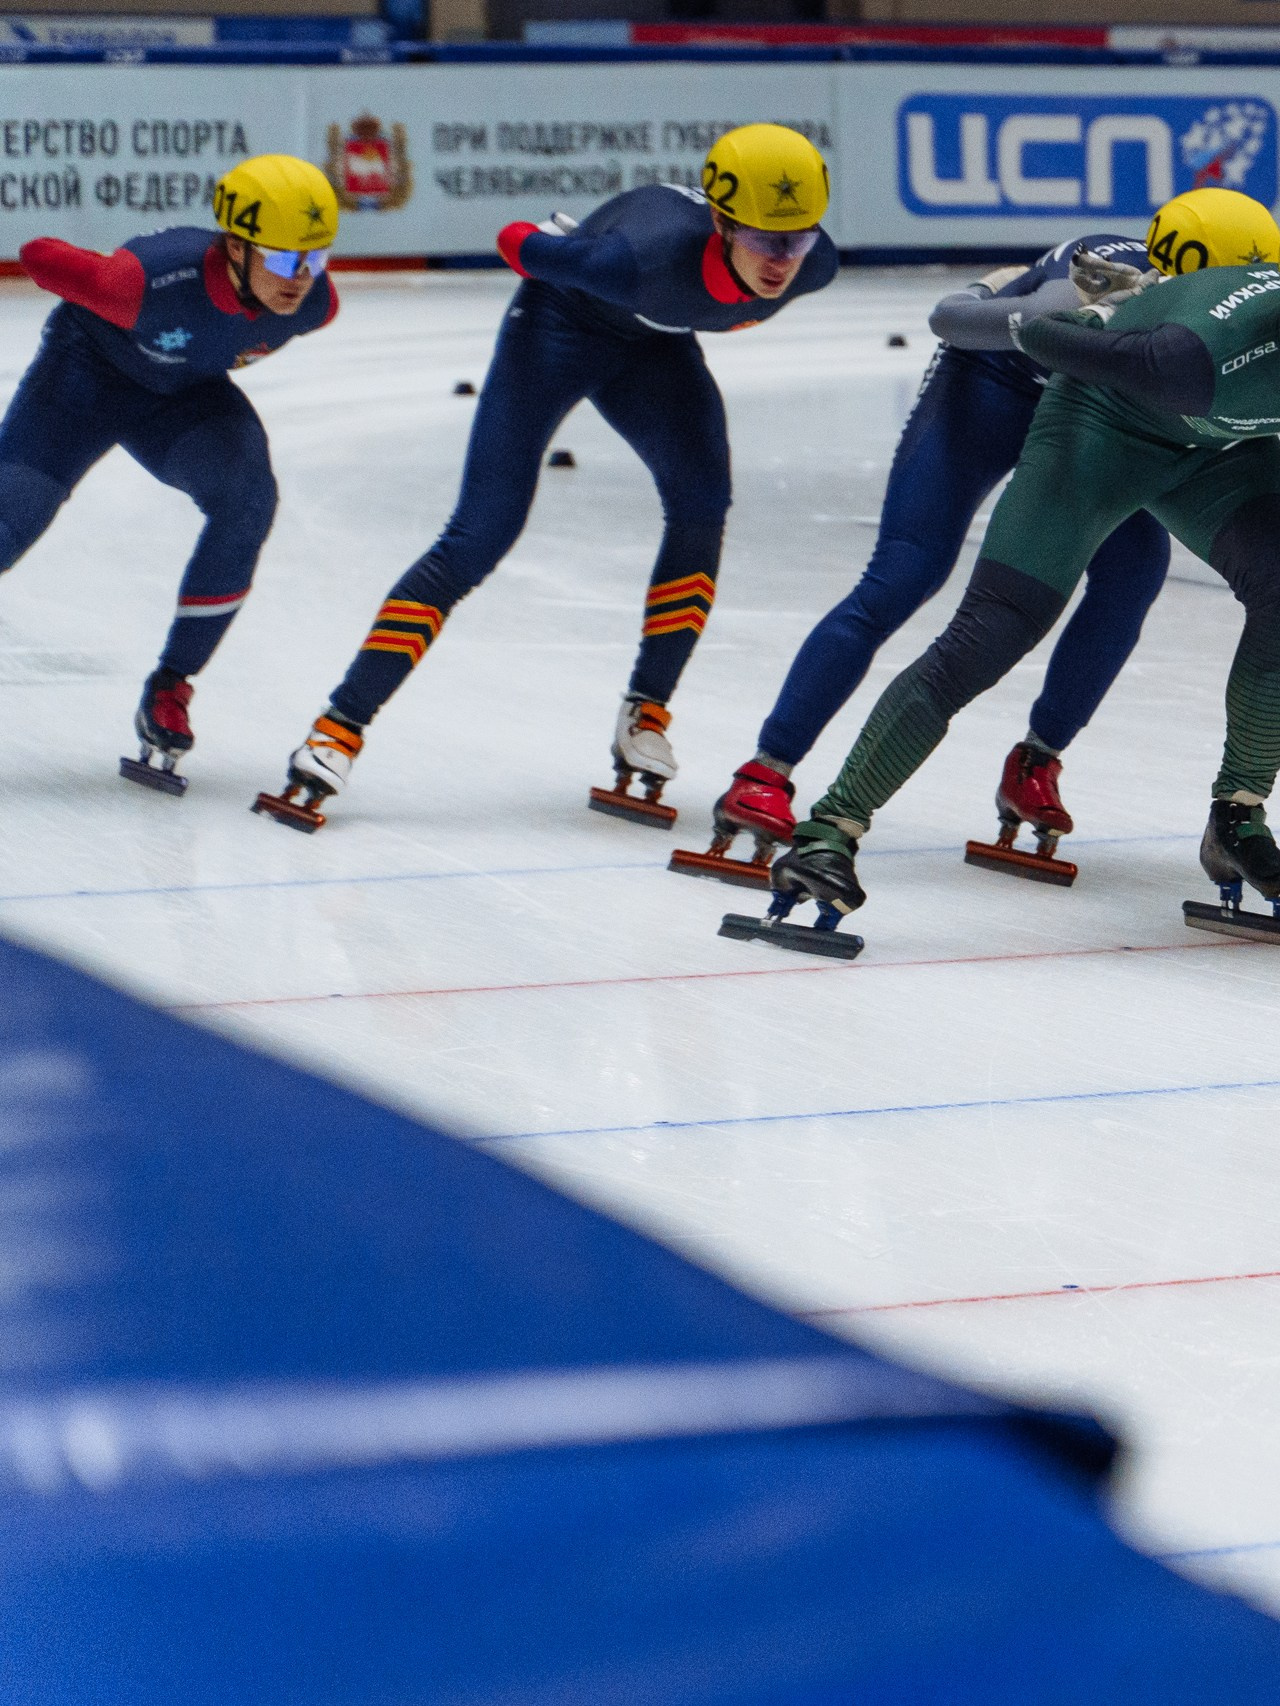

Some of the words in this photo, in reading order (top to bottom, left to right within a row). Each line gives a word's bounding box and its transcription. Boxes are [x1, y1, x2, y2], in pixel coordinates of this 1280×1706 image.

[0, 119, 119, 157] ЕРСТВО
[132, 119, 249, 157] СПОРТА
[432, 122, 488, 152] ПРИ
[497, 122, 651, 156] ПОДДЕРЖКЕ
[906, 112, 1174, 206] ЦСП
[1, 164, 82, 210] СКОЙ
[1221, 341, 1279, 375] corsa
